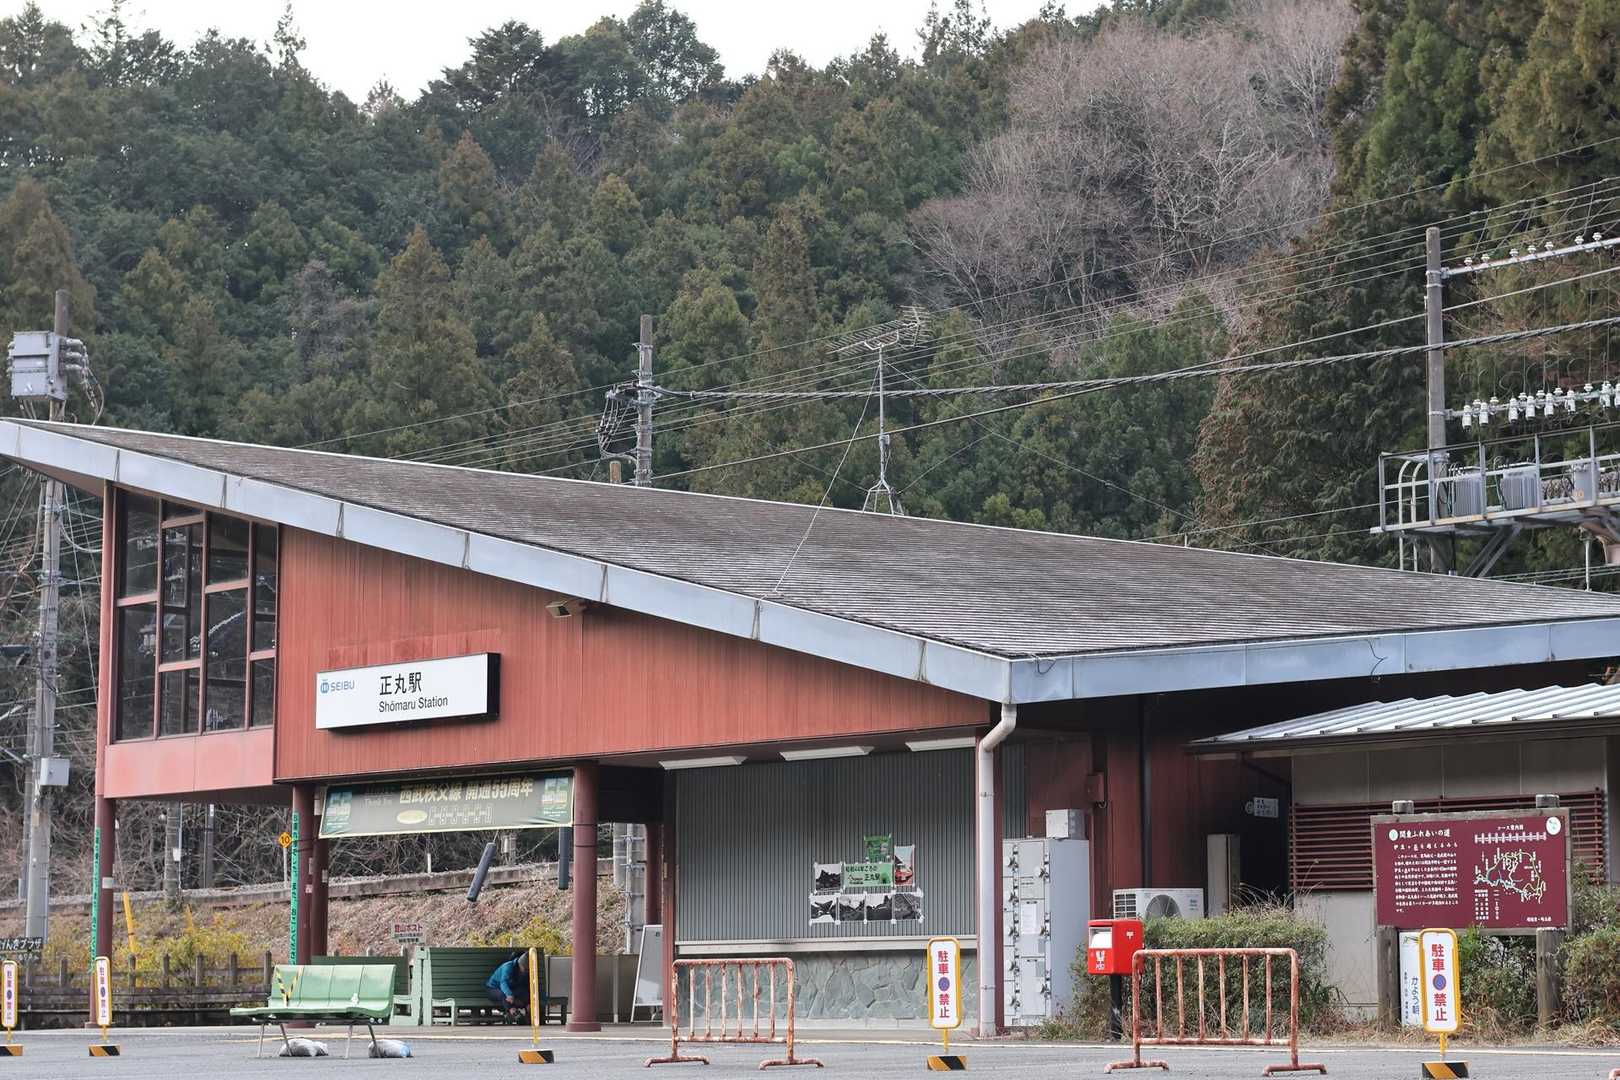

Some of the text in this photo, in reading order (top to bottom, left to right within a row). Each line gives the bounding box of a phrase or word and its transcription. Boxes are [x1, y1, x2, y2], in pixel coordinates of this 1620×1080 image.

[330, 680, 355, 692] SEIBU
[379, 672, 422, 696] 正丸駅
[418, 695, 448, 709] Station
[281, 836, 290, 845] 10
